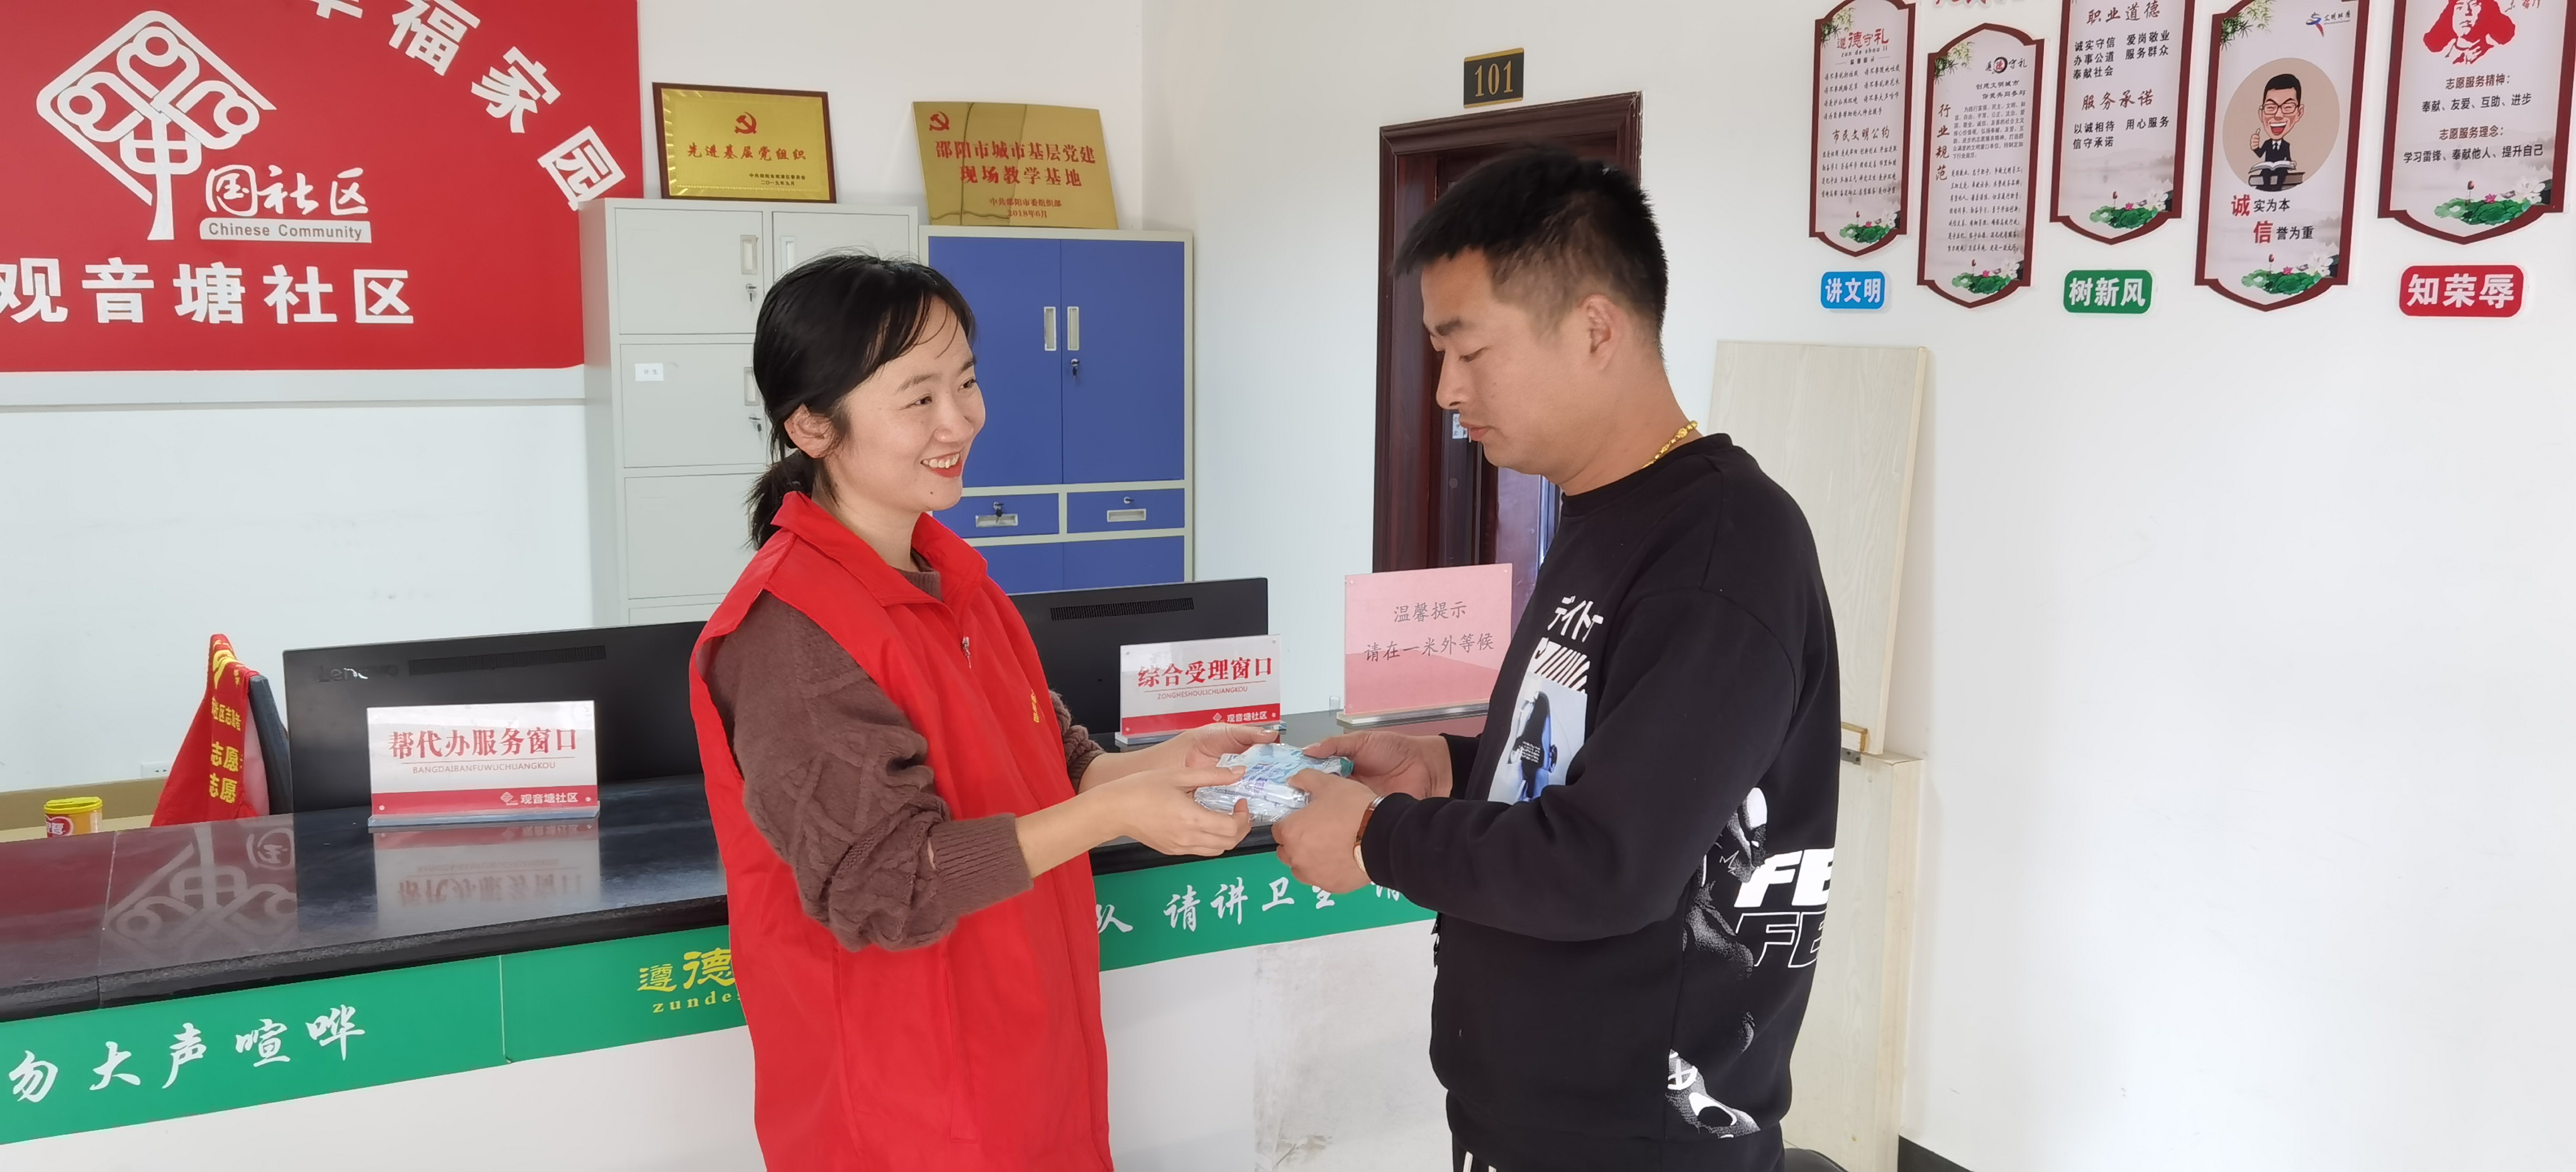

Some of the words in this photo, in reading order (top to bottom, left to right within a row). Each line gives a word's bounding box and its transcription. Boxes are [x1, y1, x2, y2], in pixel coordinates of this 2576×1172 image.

[2086, 1, 2160, 26] 职业道德
[2074, 36, 2116, 52] 诚实守信
[2126, 30, 2170, 47] 爱岗敬业
[2073, 50, 2114, 67] 办事公道
[2125, 44, 2169, 61] 服务群众
[1474, 60, 1514, 97] 101
[2072, 66, 2114, 80] 奉献社会
[2081, 89, 2154, 111] 服务承诺
[1832, 126, 1890, 144] 市民文明公约
[2073, 121, 2115, 135] 以诚相待
[2125, 118, 2170, 131] 用心服务
[687, 142, 806, 162] 先进基层党组织
[935, 140, 1096, 164] 邵阳市城市基层党建
[1935, 103, 1951, 181] 行业规范
[2072, 136, 2114, 150] 信守承诺
[960, 165, 1082, 187] 现场教学基地
[206, 164, 369, 217] 国社区
[2230, 194, 2290, 216] 诚实为本
[208, 222, 270, 236] Chinese
[278, 223, 362, 241] Community
[2253, 220, 2315, 244] 信誉为重
[0, 257, 414, 324] 观音塘社区
[1825, 277, 1881, 304] 讲文明
[2068, 277, 2146, 307] 树新风
[2406, 273, 2514, 309] 知荣辱
[1393, 600, 1467, 622] 温馨提示
[1363, 632, 1495, 663] 请在一米外等候
[1138, 656, 1272, 688] 综合受理窗口
[1157, 686, 1248, 700] ZONGHESHOULICHUANGKOU
[1226, 710, 1268, 724] 观音塘社区
[387, 726, 577, 760] 帮代办服务窗口
[412, 761, 557, 775] BANGDAIBANFUWUCHUANGKOU
[520, 792, 579, 805] 观音塘社区
[653, 990, 740, 1014] zunde
[8, 1004, 365, 1103] 勿大声喧哗
